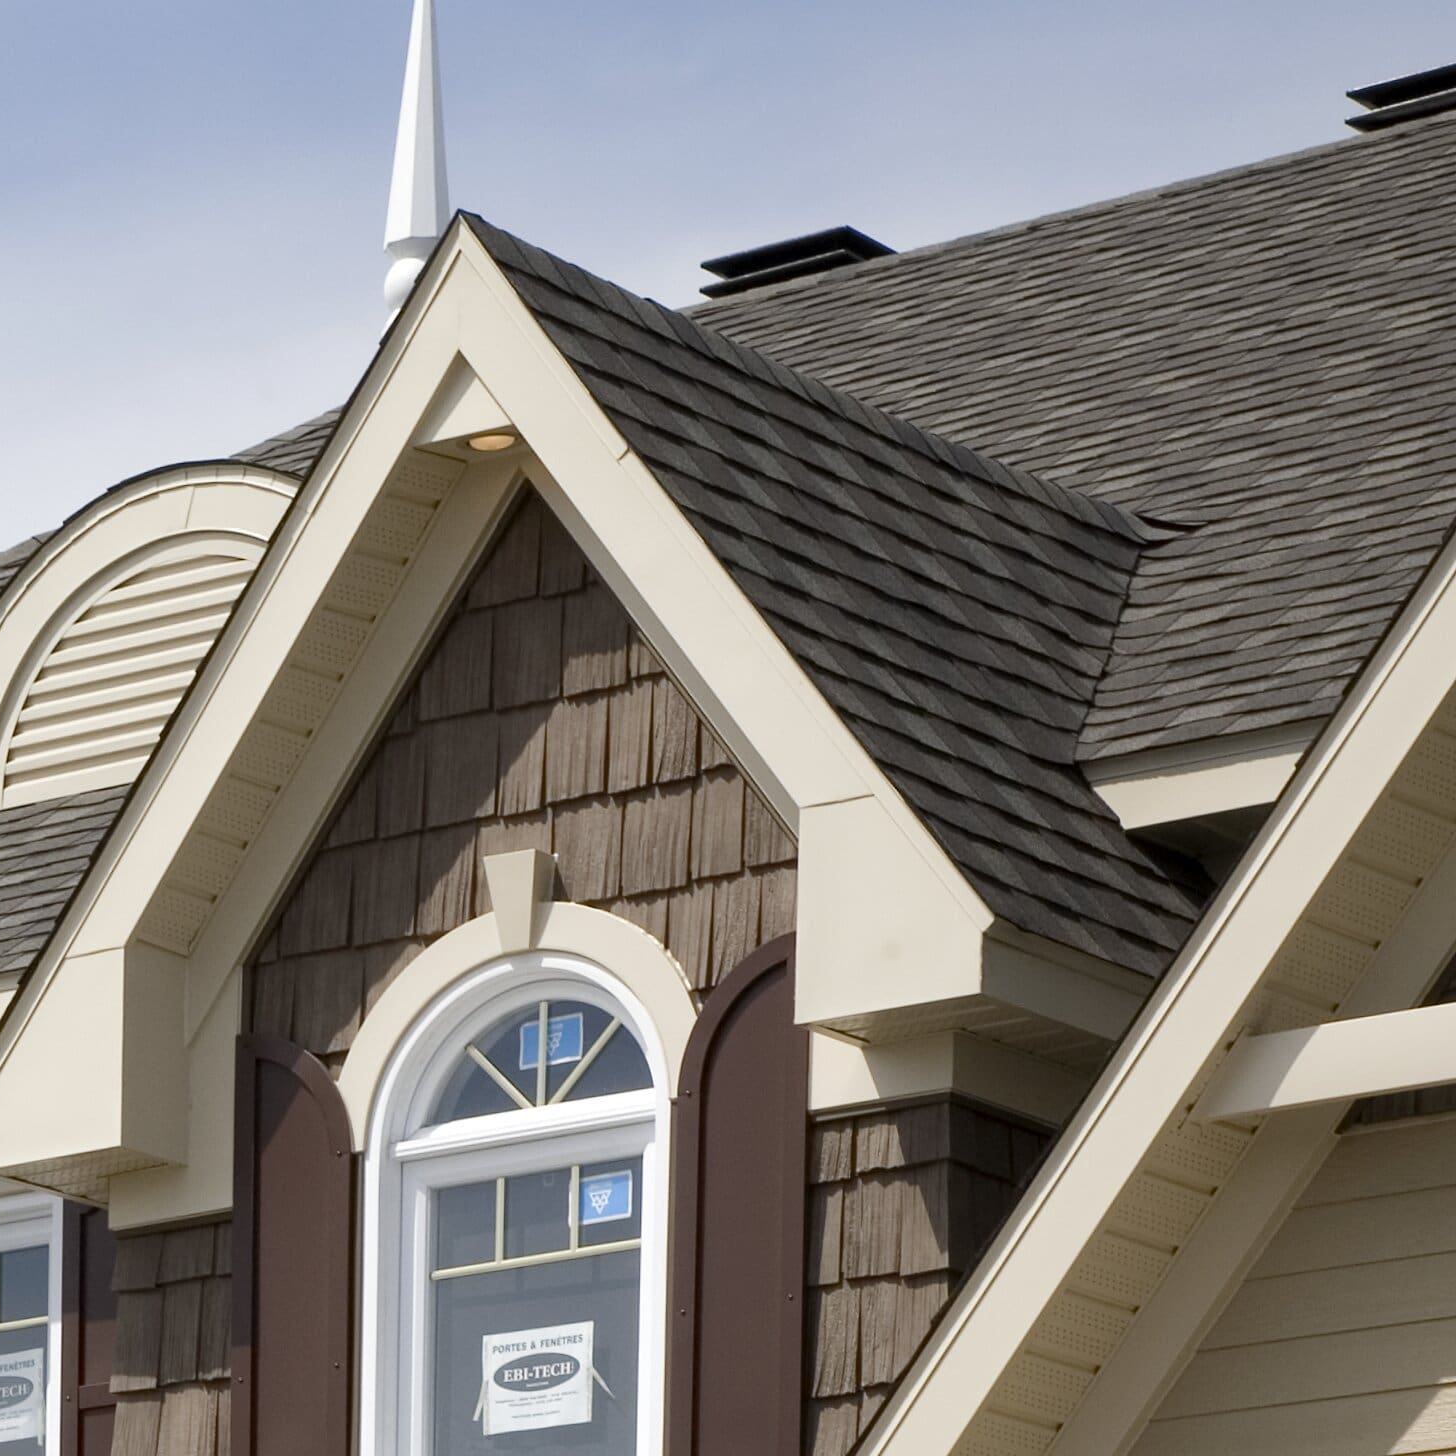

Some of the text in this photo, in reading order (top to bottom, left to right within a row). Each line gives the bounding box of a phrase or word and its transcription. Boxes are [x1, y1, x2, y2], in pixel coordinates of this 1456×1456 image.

[492, 1342, 527, 1354] PORTES
[530, 1341, 536, 1350] &
[503, 1362, 572, 1383] EBI-TECH
